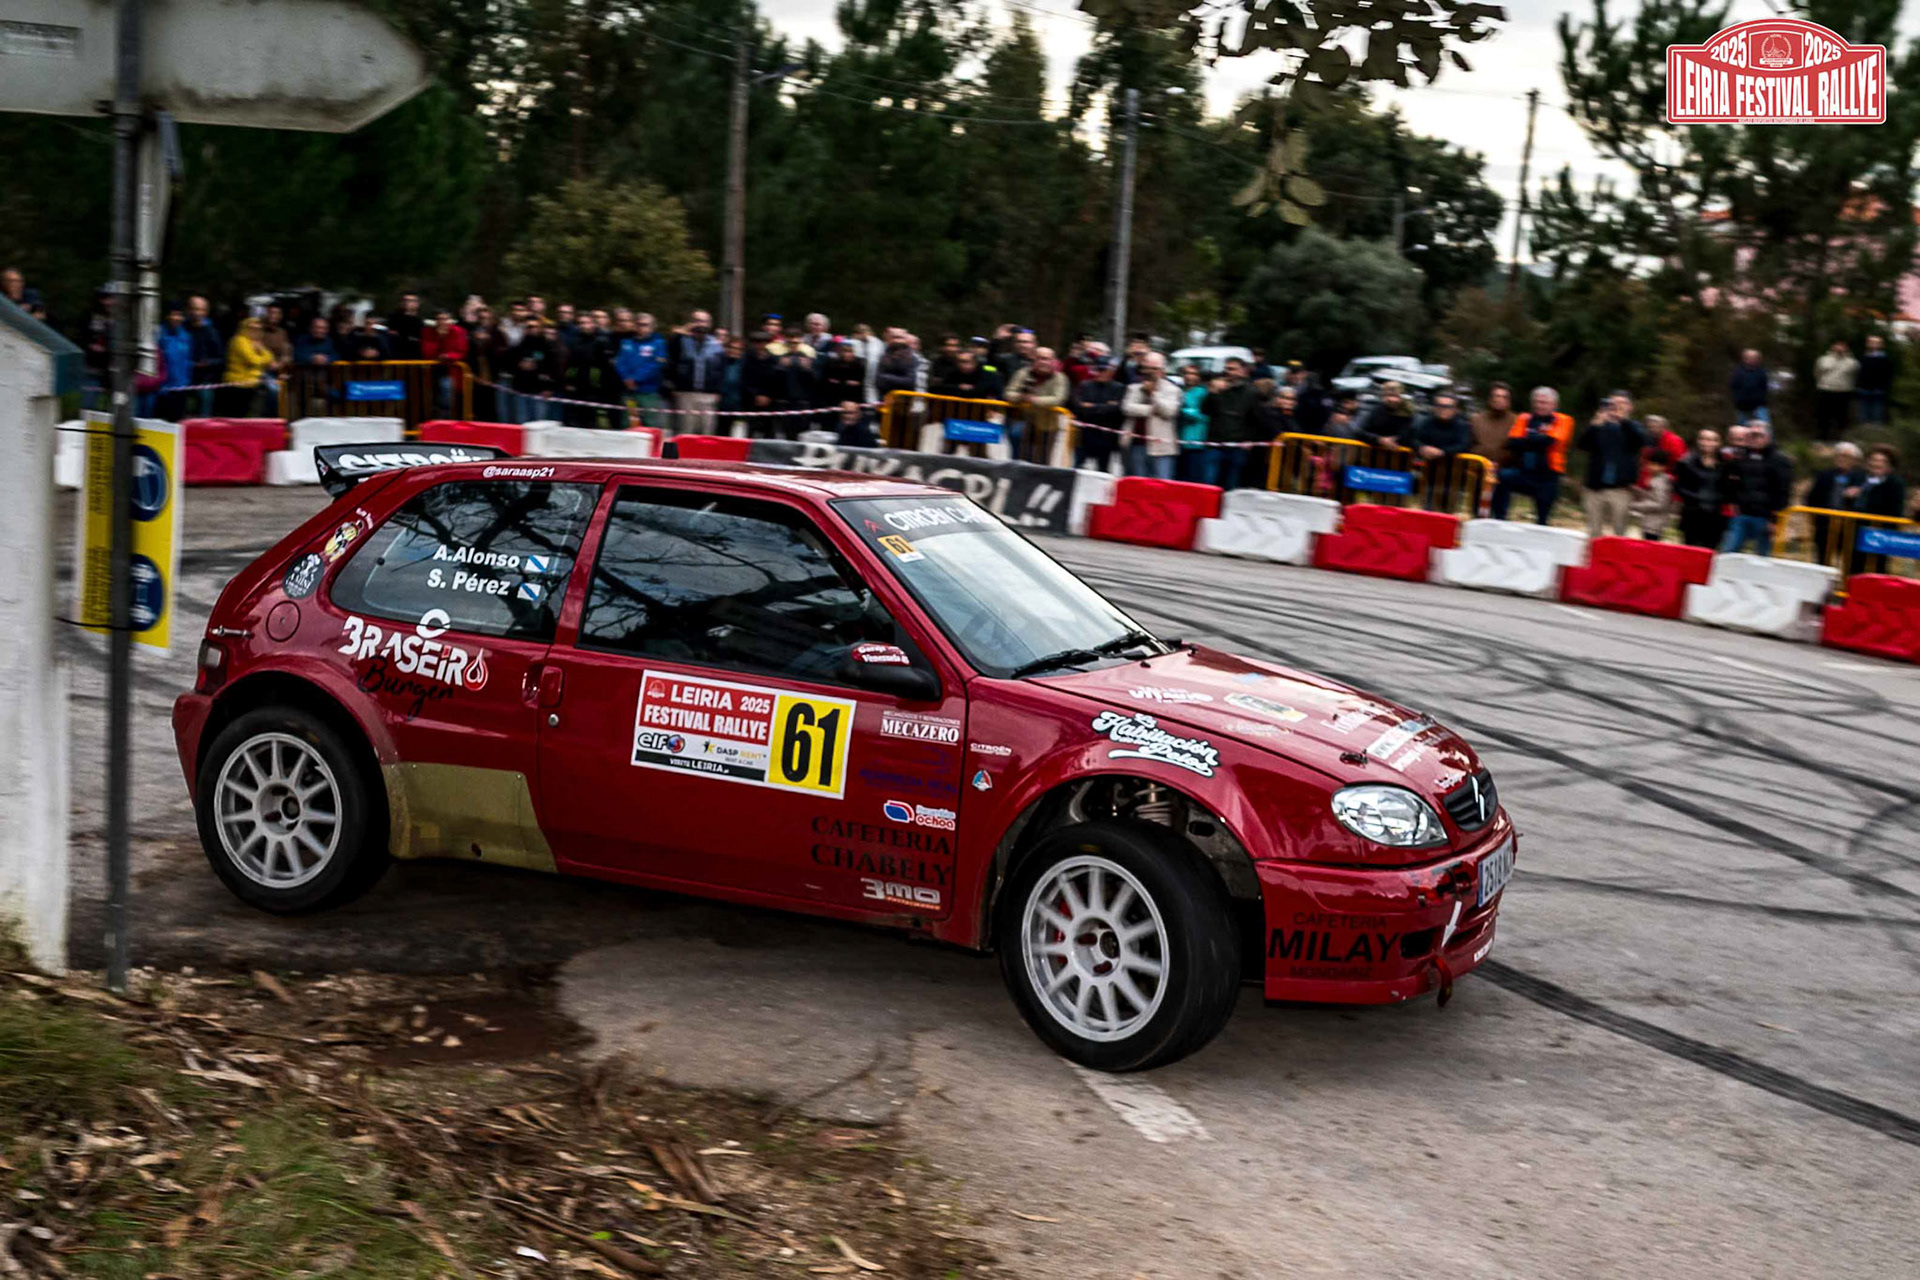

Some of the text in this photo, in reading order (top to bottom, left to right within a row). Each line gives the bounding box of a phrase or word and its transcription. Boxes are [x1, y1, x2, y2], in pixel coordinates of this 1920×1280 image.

[482, 466, 555, 478] @saraasp21
[432, 545, 520, 568] A.Alonso
[885, 537, 914, 554] 61
[427, 569, 511, 596] S. Pérez
[671, 684, 770, 714] LEIRIA 2025
[644, 704, 768, 740] FESTIVAL RALLYE
[882, 719, 960, 743] MECAZERO
[781, 702, 841, 787] 61
[811, 815, 952, 855] CAFETERIA
[916, 815, 956, 830] ochoa
[811, 843, 952, 886] CHABELY
[1293, 911, 1387, 929] CAFETERIA
[1268, 927, 1400, 963] MILAY
